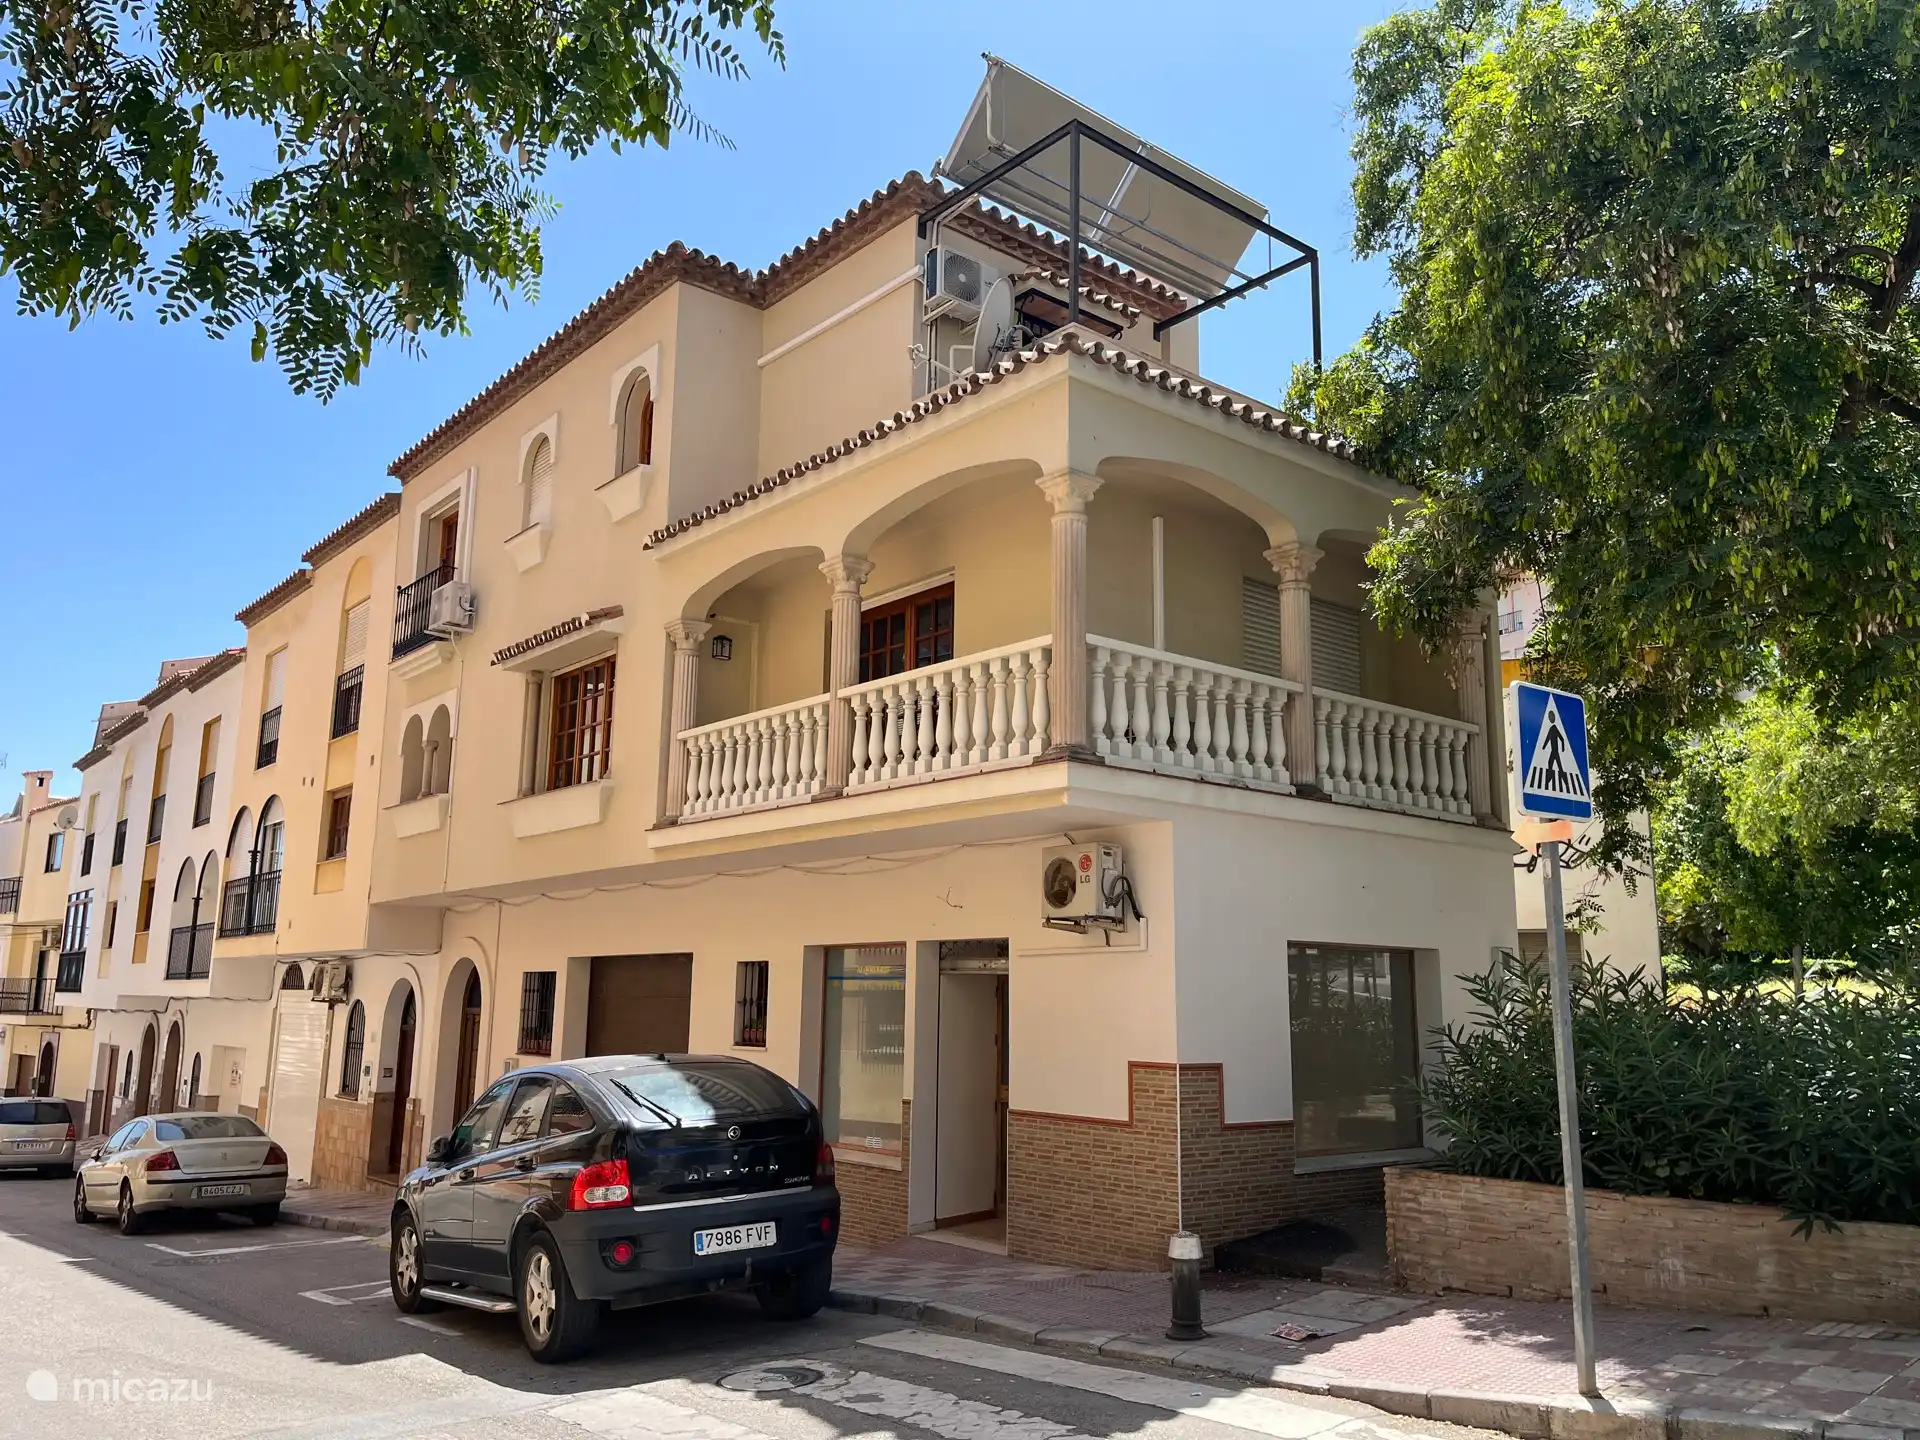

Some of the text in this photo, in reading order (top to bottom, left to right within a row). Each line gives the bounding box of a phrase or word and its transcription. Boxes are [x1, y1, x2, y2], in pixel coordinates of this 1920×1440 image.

[1079, 875, 1091, 883] LG
[688, 1165, 779, 1181] ACTYON
[203, 1187, 225, 1195] 8405
[705, 1225, 771, 1249] 7986 FVF
